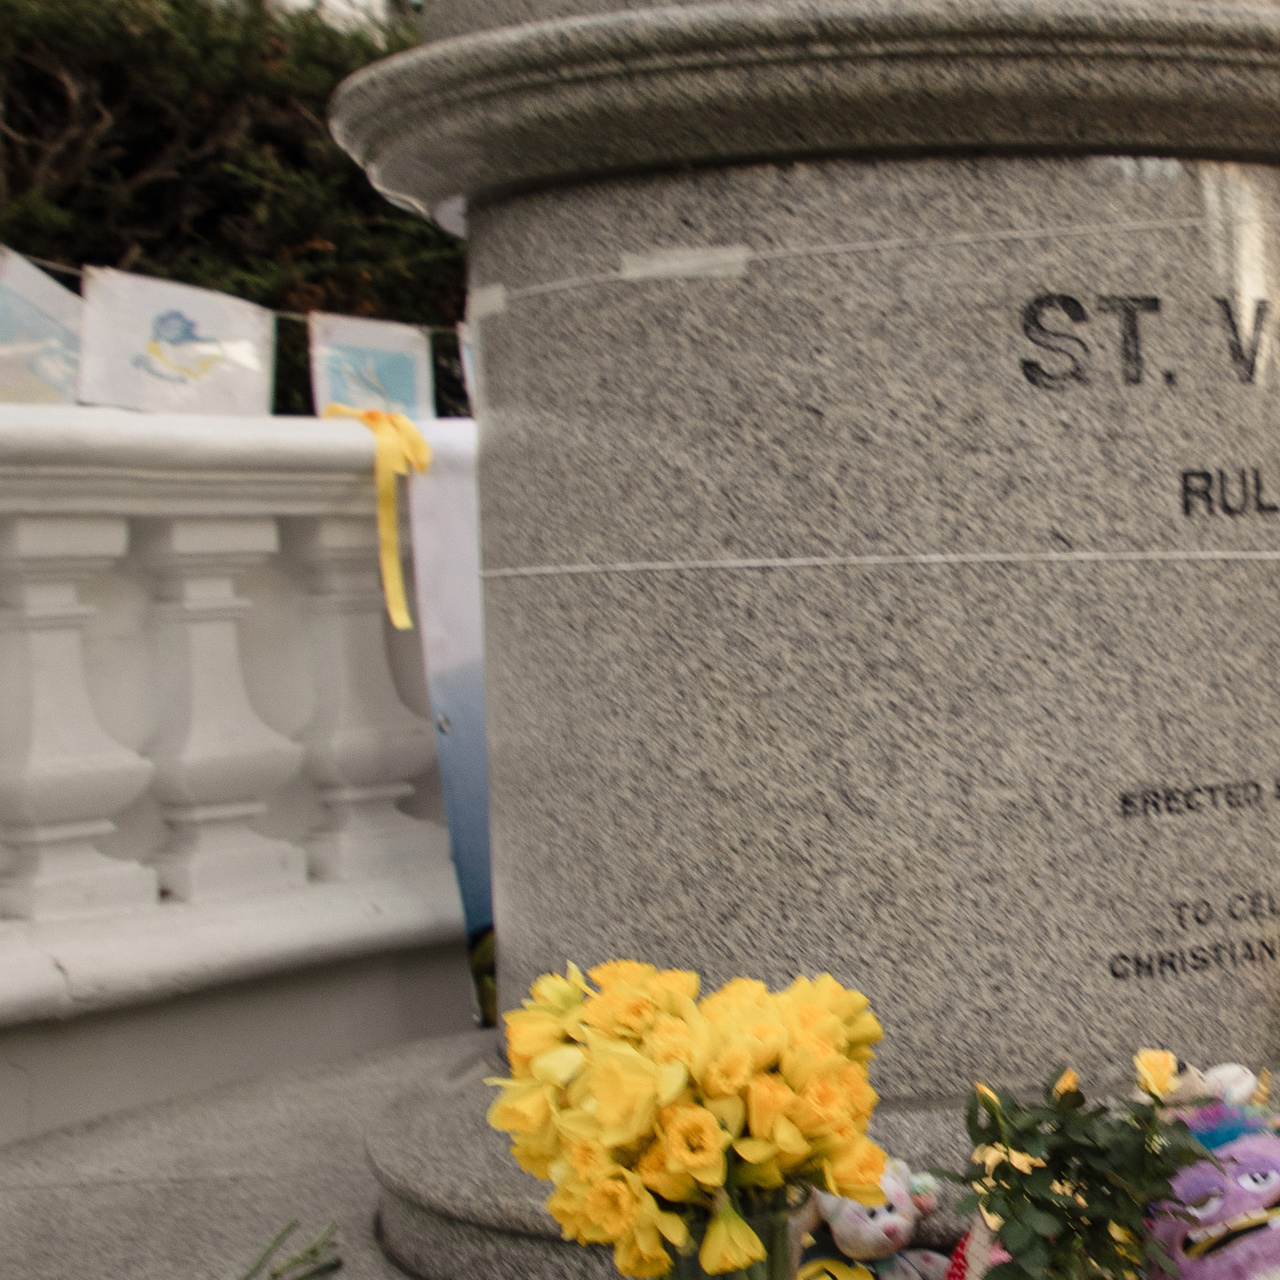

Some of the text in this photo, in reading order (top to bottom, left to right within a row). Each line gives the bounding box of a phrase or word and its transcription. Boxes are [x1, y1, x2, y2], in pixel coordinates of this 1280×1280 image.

[1019, 292, 1176, 390] ST.
[1117, 779, 1264, 819] ERECTED
[1170, 898, 1216, 930] TO
